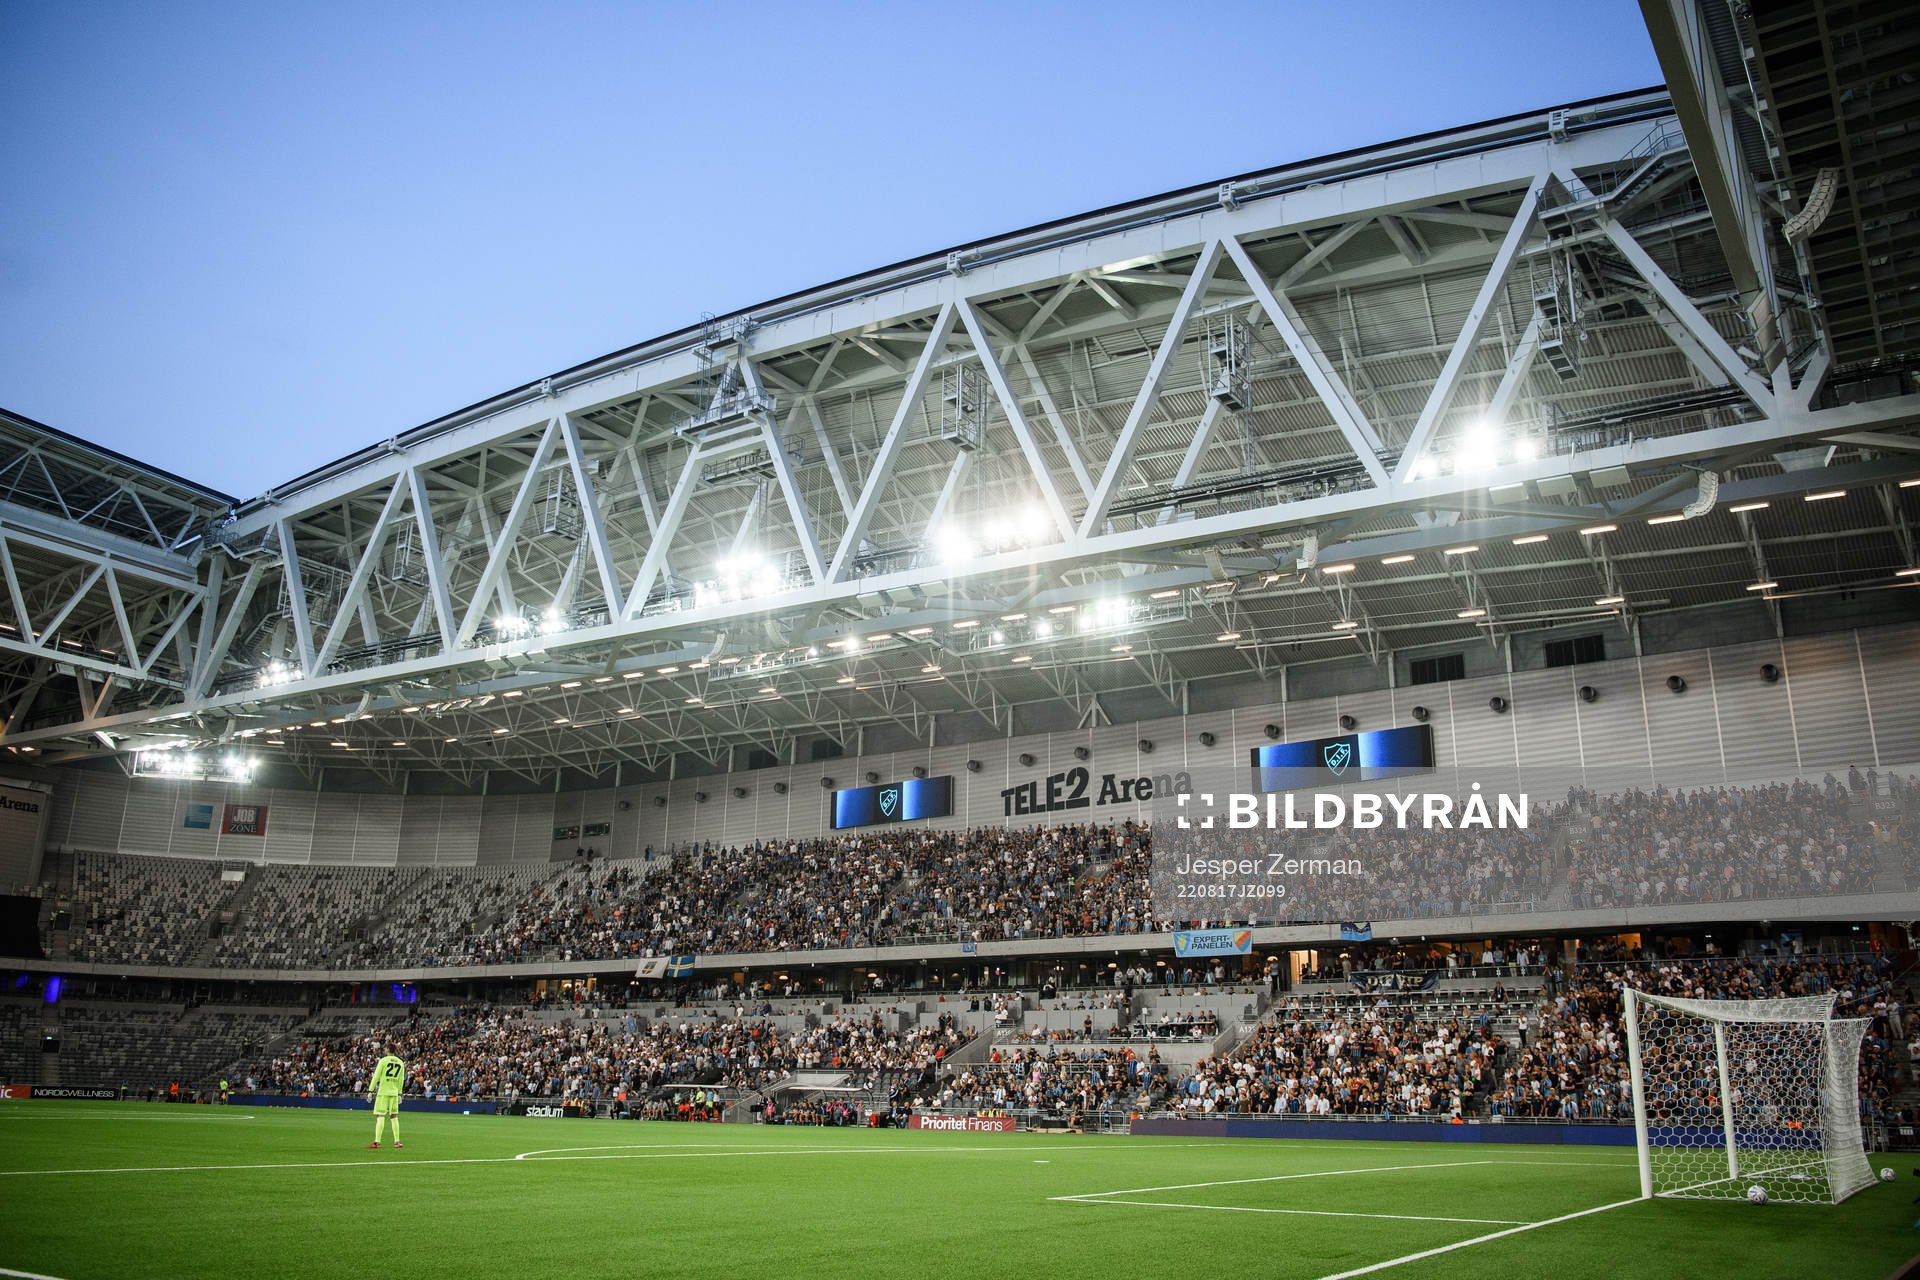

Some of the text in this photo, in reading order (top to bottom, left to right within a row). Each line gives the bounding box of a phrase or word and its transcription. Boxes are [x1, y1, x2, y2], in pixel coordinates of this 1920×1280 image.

[1001, 766, 1194, 816] TELE2 Arena
[233, 808, 255, 823] JOB
[230, 823, 257, 833] ZONE
[1191, 941, 1233, 950] PANELEN
[1194, 935, 1230, 943] EXPERT-
[385, 1062, 401, 1078] 27
[0, 1085, 13, 1098] ic
[526, 1104, 564, 1118] stadium
[920, 1116, 1003, 1131] Prioritet Finans
